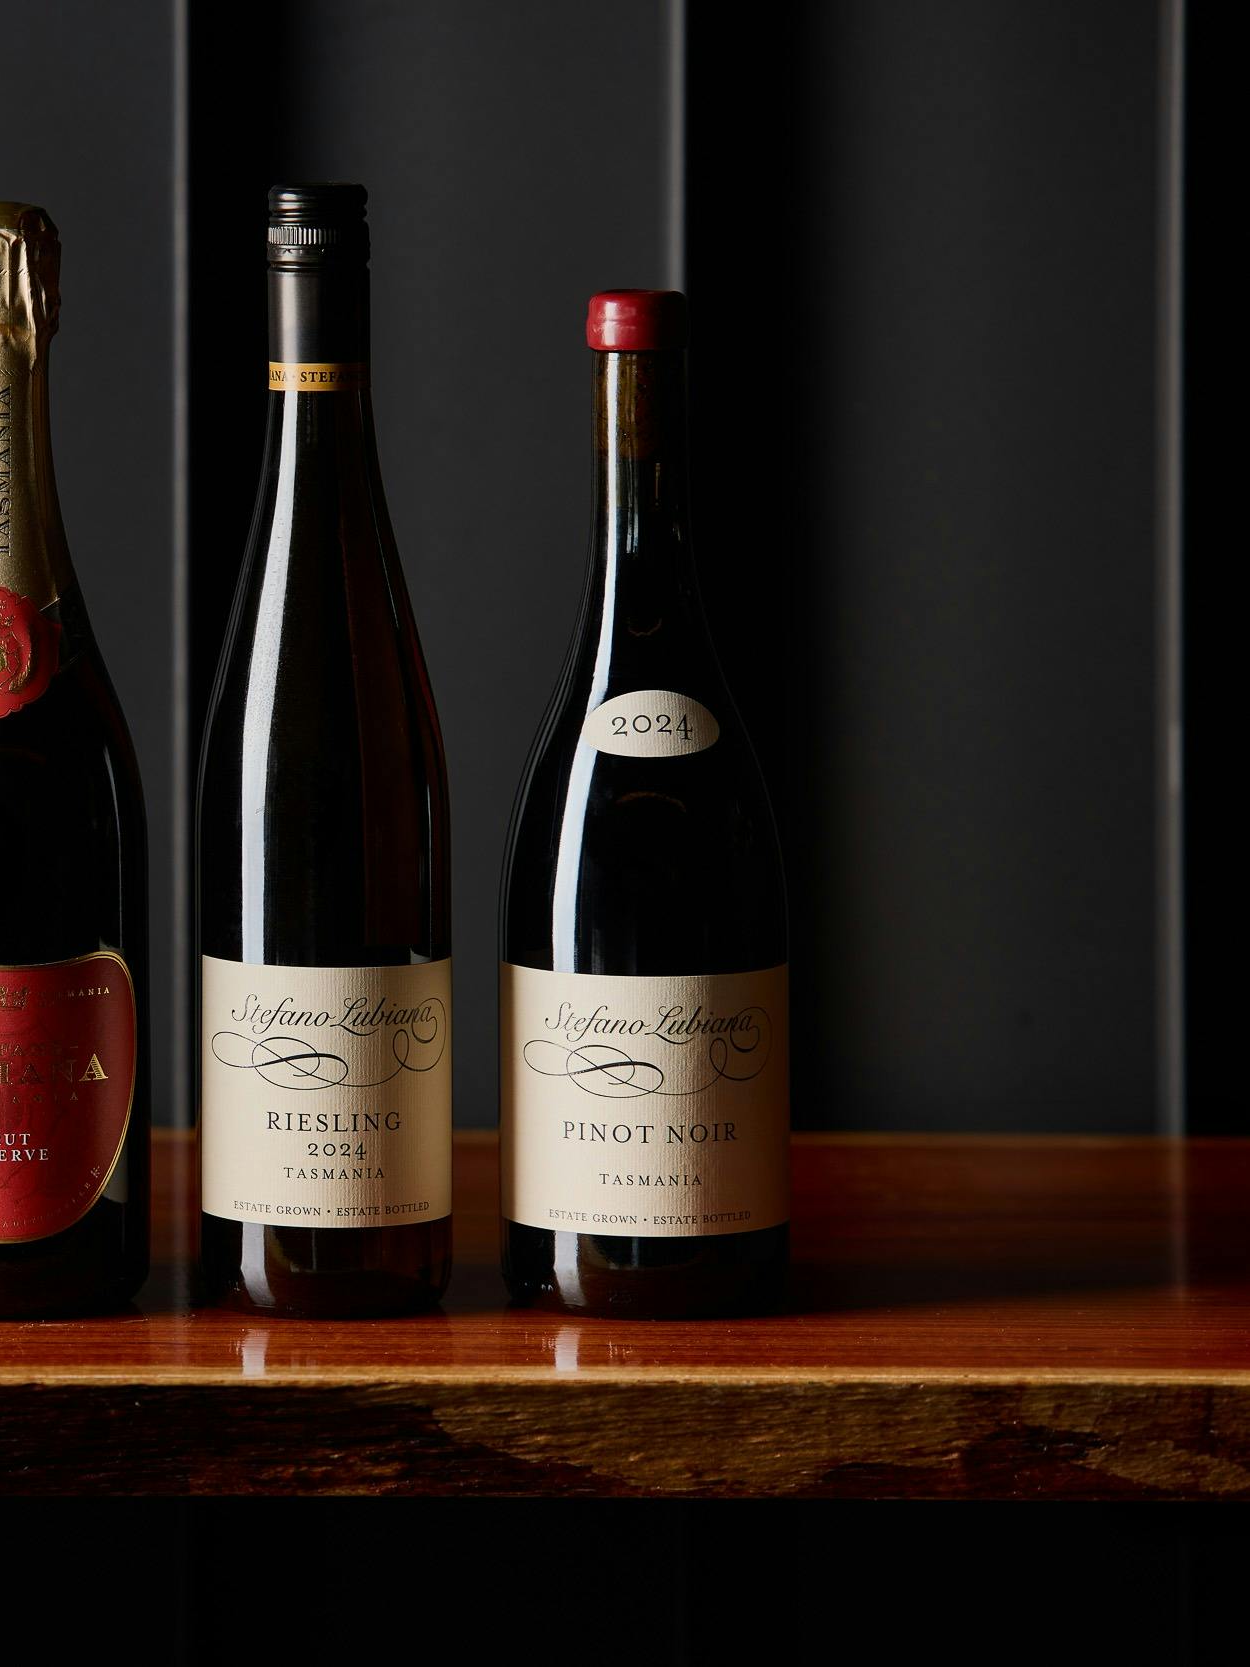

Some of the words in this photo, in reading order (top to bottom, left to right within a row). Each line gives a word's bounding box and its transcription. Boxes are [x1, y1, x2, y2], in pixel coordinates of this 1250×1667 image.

[611, 713, 693, 741] 2024
[231, 993, 335, 1035] Stefano
[330, 996, 435, 1040] Lubiana
[545, 1001, 649, 1042] Stefano
[644, 1005, 756, 1049] Lubiana
[267, 1111, 402, 1133] RIESLING
[562, 1120, 654, 1144] PINOT
[666, 1121, 739, 1144] NOIR
[307, 1142, 367, 1161] 2024
[283, 1167, 385, 1180] TASMANIA
[599, 1173, 702, 1187] TASMANIA
[233, 1200, 272, 1214] ESTATE
[276, 1205, 321, 1217] GROWN
[336, 1206, 380, 1217] ESTATE
[385, 1201, 430, 1215] BOTTLED
[549, 1208, 588, 1222] ESTATE
[592, 1213, 638, 1225] GROWN
[653, 1215, 698, 1225] ESTATE
[702, 1210, 751, 1224] BOTTLED
